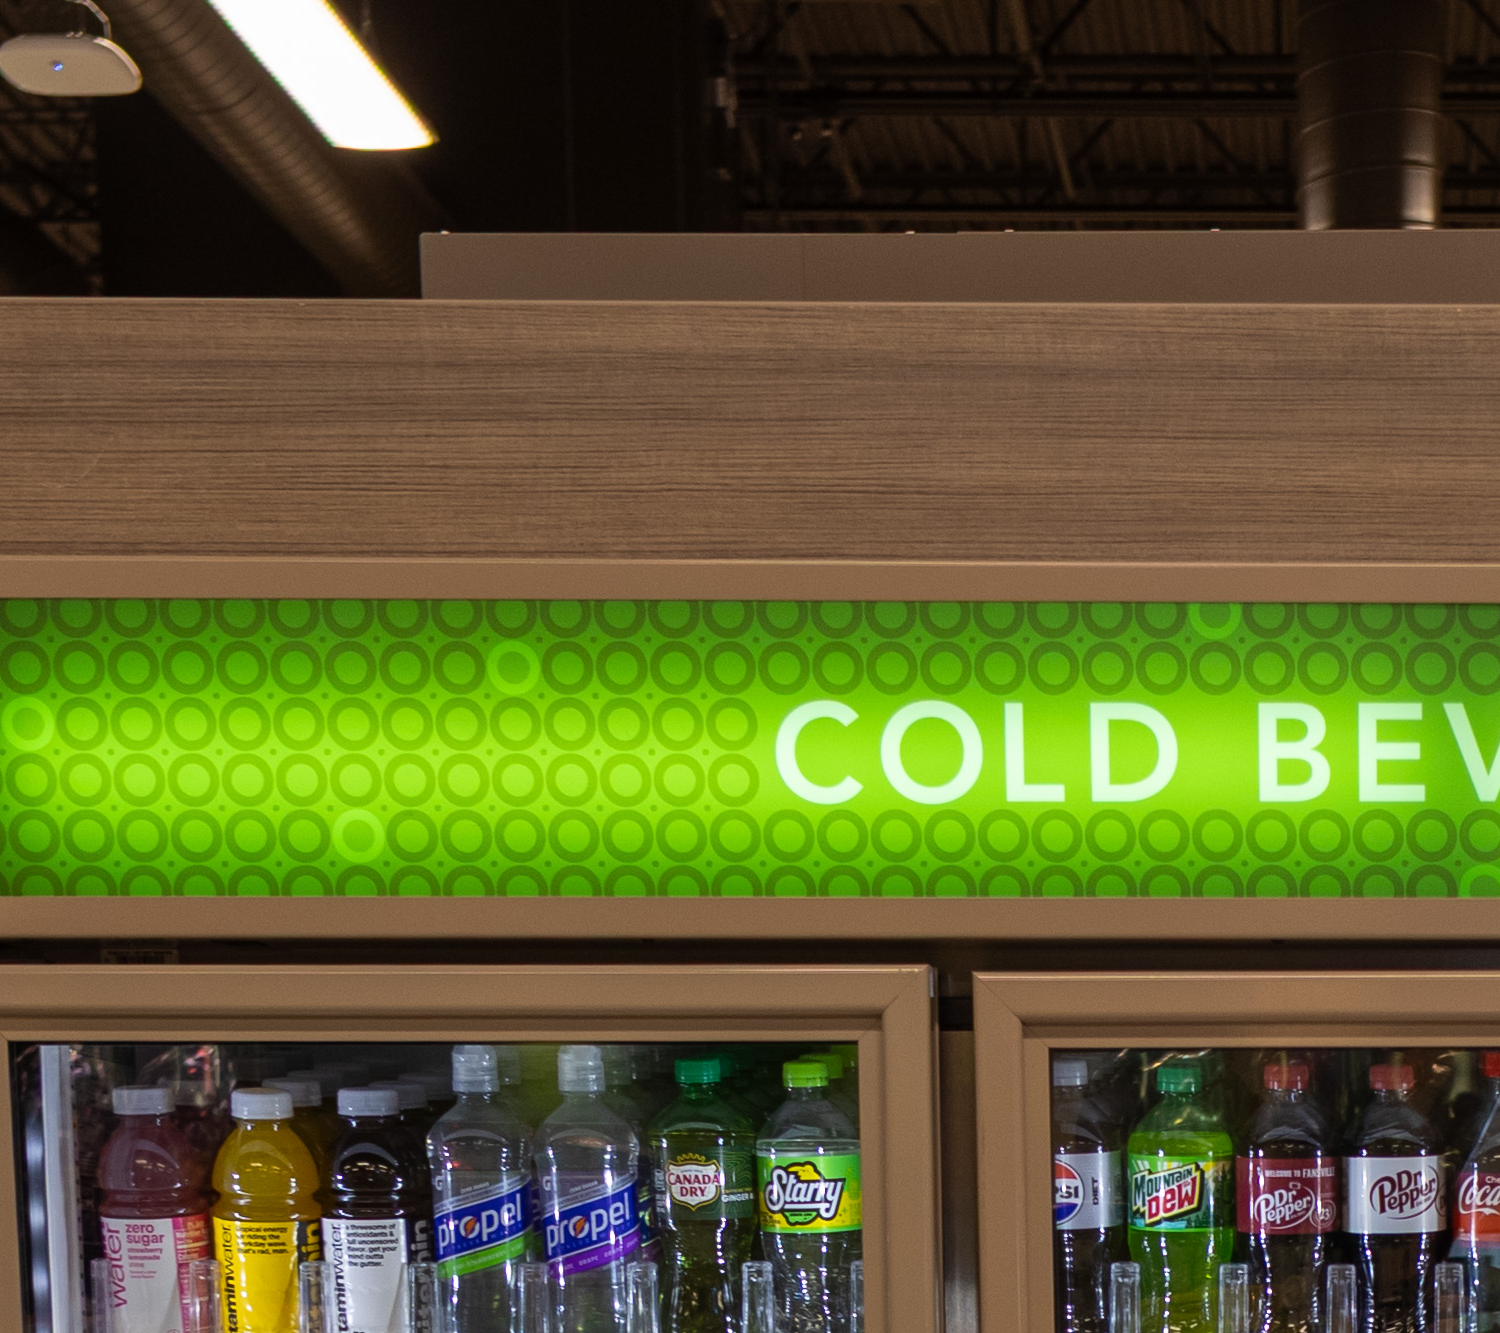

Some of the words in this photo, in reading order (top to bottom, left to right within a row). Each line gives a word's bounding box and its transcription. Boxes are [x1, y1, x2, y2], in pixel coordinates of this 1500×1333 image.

[775, 700, 1180, 803] COLD
[668, 1172, 719, 1186] CANADA
[1398, 1170, 1422, 1186] Dr
[679, 1185, 707, 1198] DRY
[765, 1169, 845, 1218] Starry
[1277, 1187, 1296, 1204] Dr
[1375, 1179, 1435, 1215] Pepper
[437, 1194, 522, 1249] propel
[1256, 1195, 1312, 1225] Pepper
[124, 1224, 156, 1234] zero
[546, 1194, 632, 1250] propel
[126, 1234, 165, 1245] sugar
